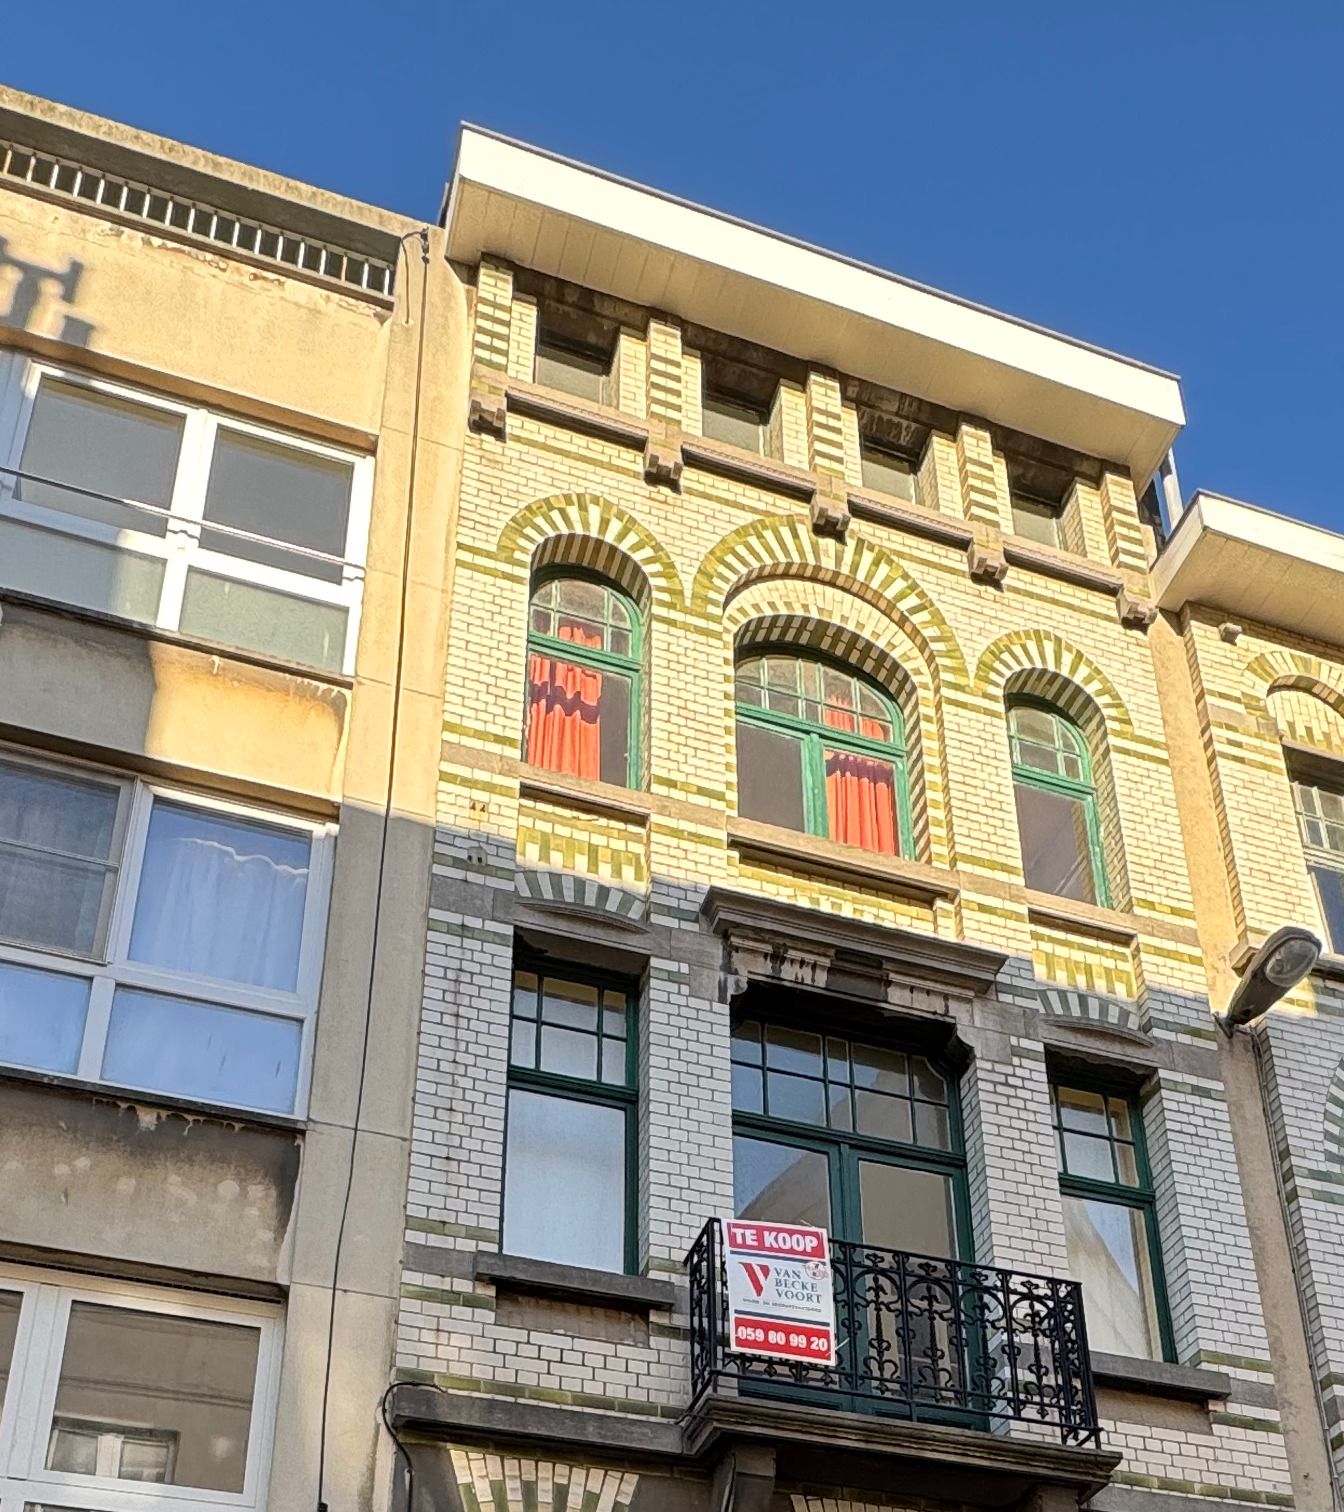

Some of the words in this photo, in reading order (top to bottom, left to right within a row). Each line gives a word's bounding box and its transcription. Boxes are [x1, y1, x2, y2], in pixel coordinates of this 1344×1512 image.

[731, 1228, 758, 1246] TE
[763, 1231, 818, 1252] KOOP
[774, 1267, 801, 1280] VAN
[774, 1278, 818, 1292] BECKE
[776, 1289, 822, 1304] VOORT
[737, 1326, 764, 1342] 059
[789, 1334, 807, 1349] 99
[810, 1336, 828, 1351] 20
